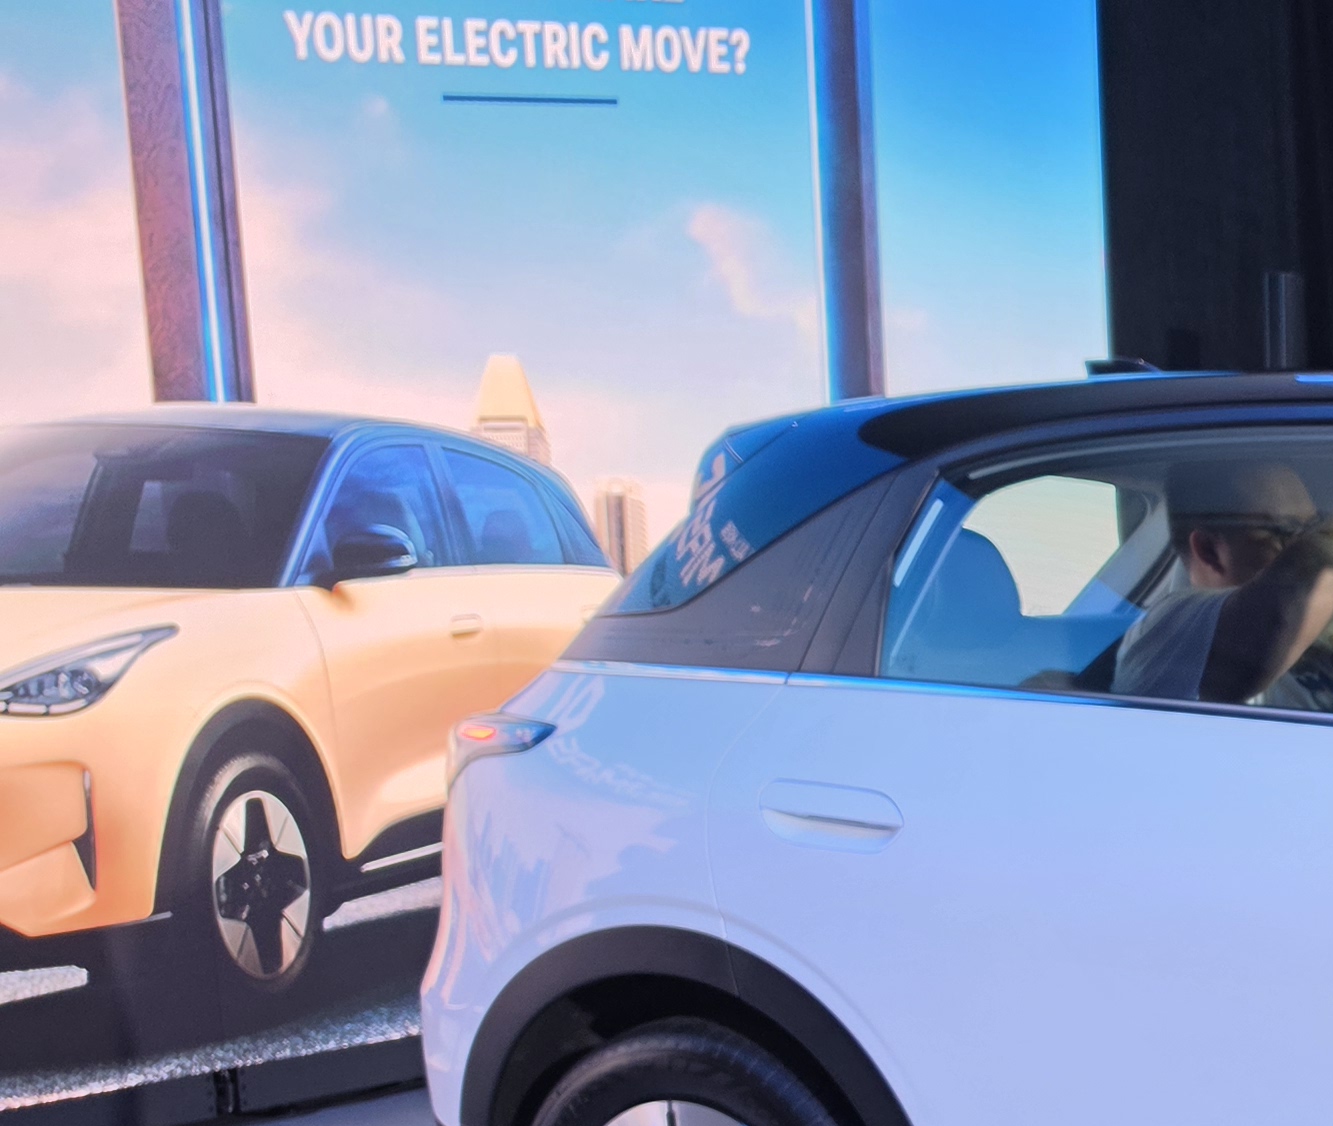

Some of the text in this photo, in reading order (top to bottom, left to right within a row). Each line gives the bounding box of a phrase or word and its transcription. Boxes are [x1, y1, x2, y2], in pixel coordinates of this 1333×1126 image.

[283, 11, 750, 75] YOUR ELECTRIC MOVE?
